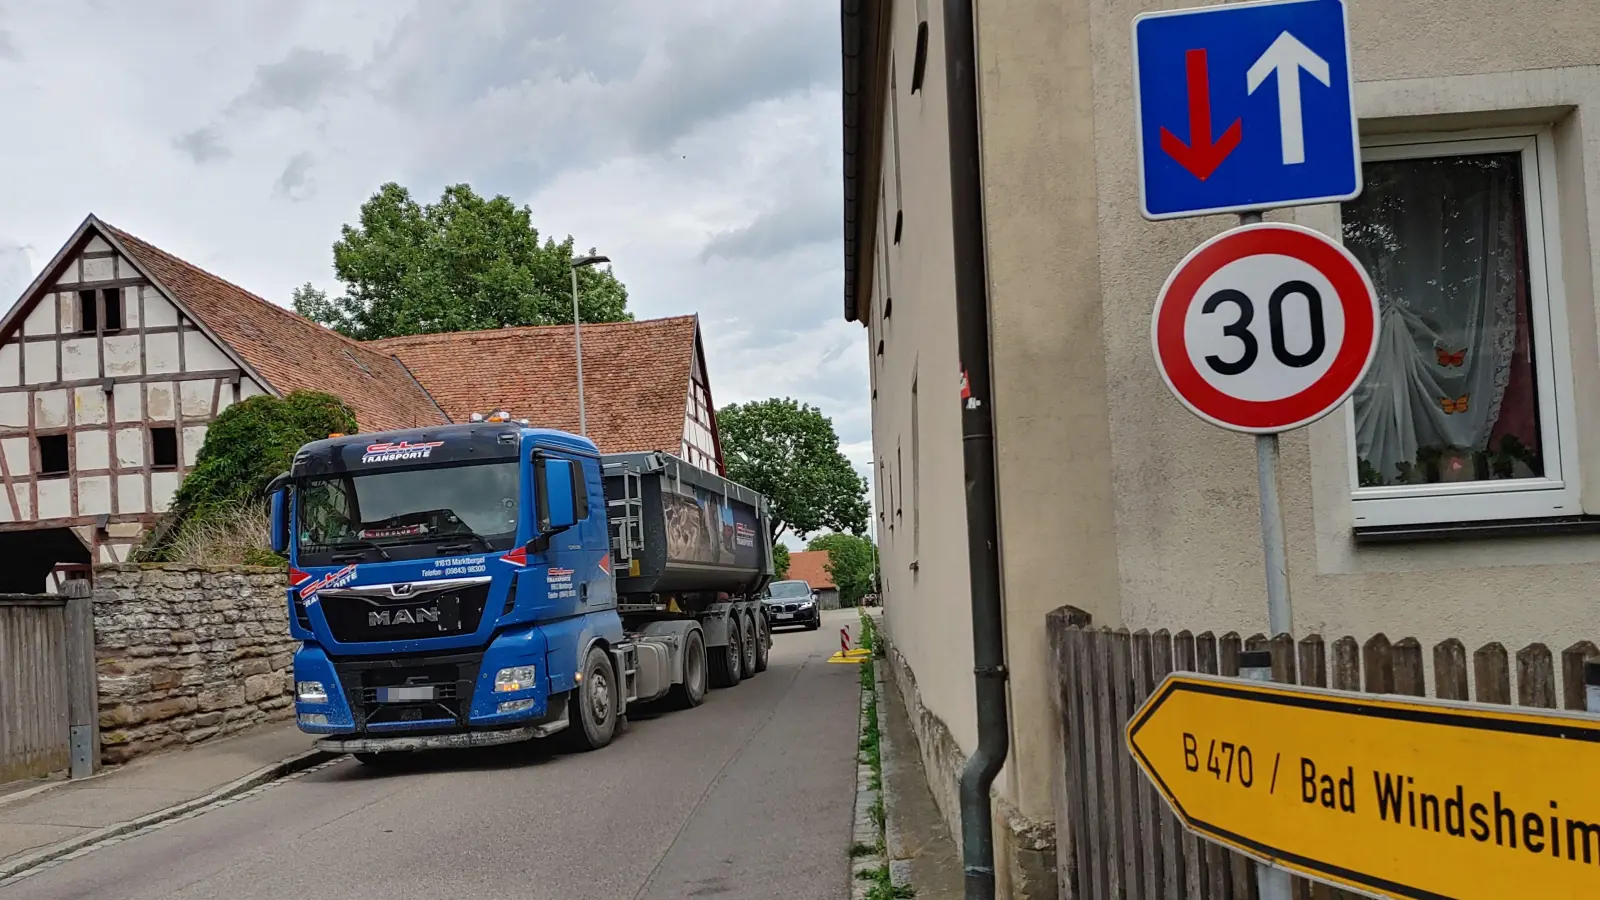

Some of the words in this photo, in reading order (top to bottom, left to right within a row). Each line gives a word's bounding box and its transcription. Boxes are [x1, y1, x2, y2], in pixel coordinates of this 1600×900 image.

[1201, 279, 1326, 376] 30
[361, 450, 431, 464] TRANSPORTE
[421, 568, 442, 577] Telefon
[368, 607, 438, 626] MAN
[1182, 731, 1199, 773] B
[1206, 738, 1254, 789] 470
[1300, 756, 1356, 814] Bad
[1373, 769, 1600, 868] Windsheim
